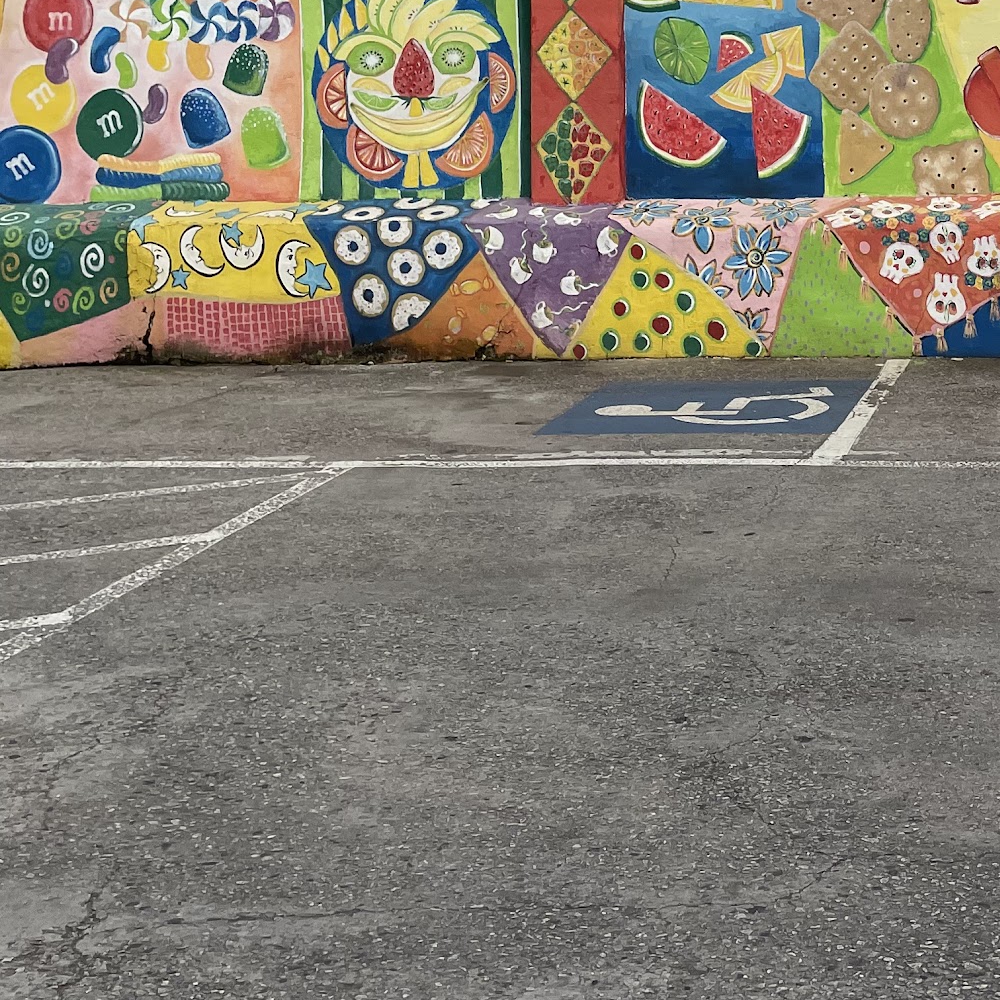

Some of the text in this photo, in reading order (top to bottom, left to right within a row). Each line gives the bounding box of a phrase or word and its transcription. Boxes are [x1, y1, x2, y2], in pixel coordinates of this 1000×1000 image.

[48, 10, 73, 32] m
[26, 82, 56, 111] m
[96, 109, 124, 138] m
[5, 152, 36, 181] m
